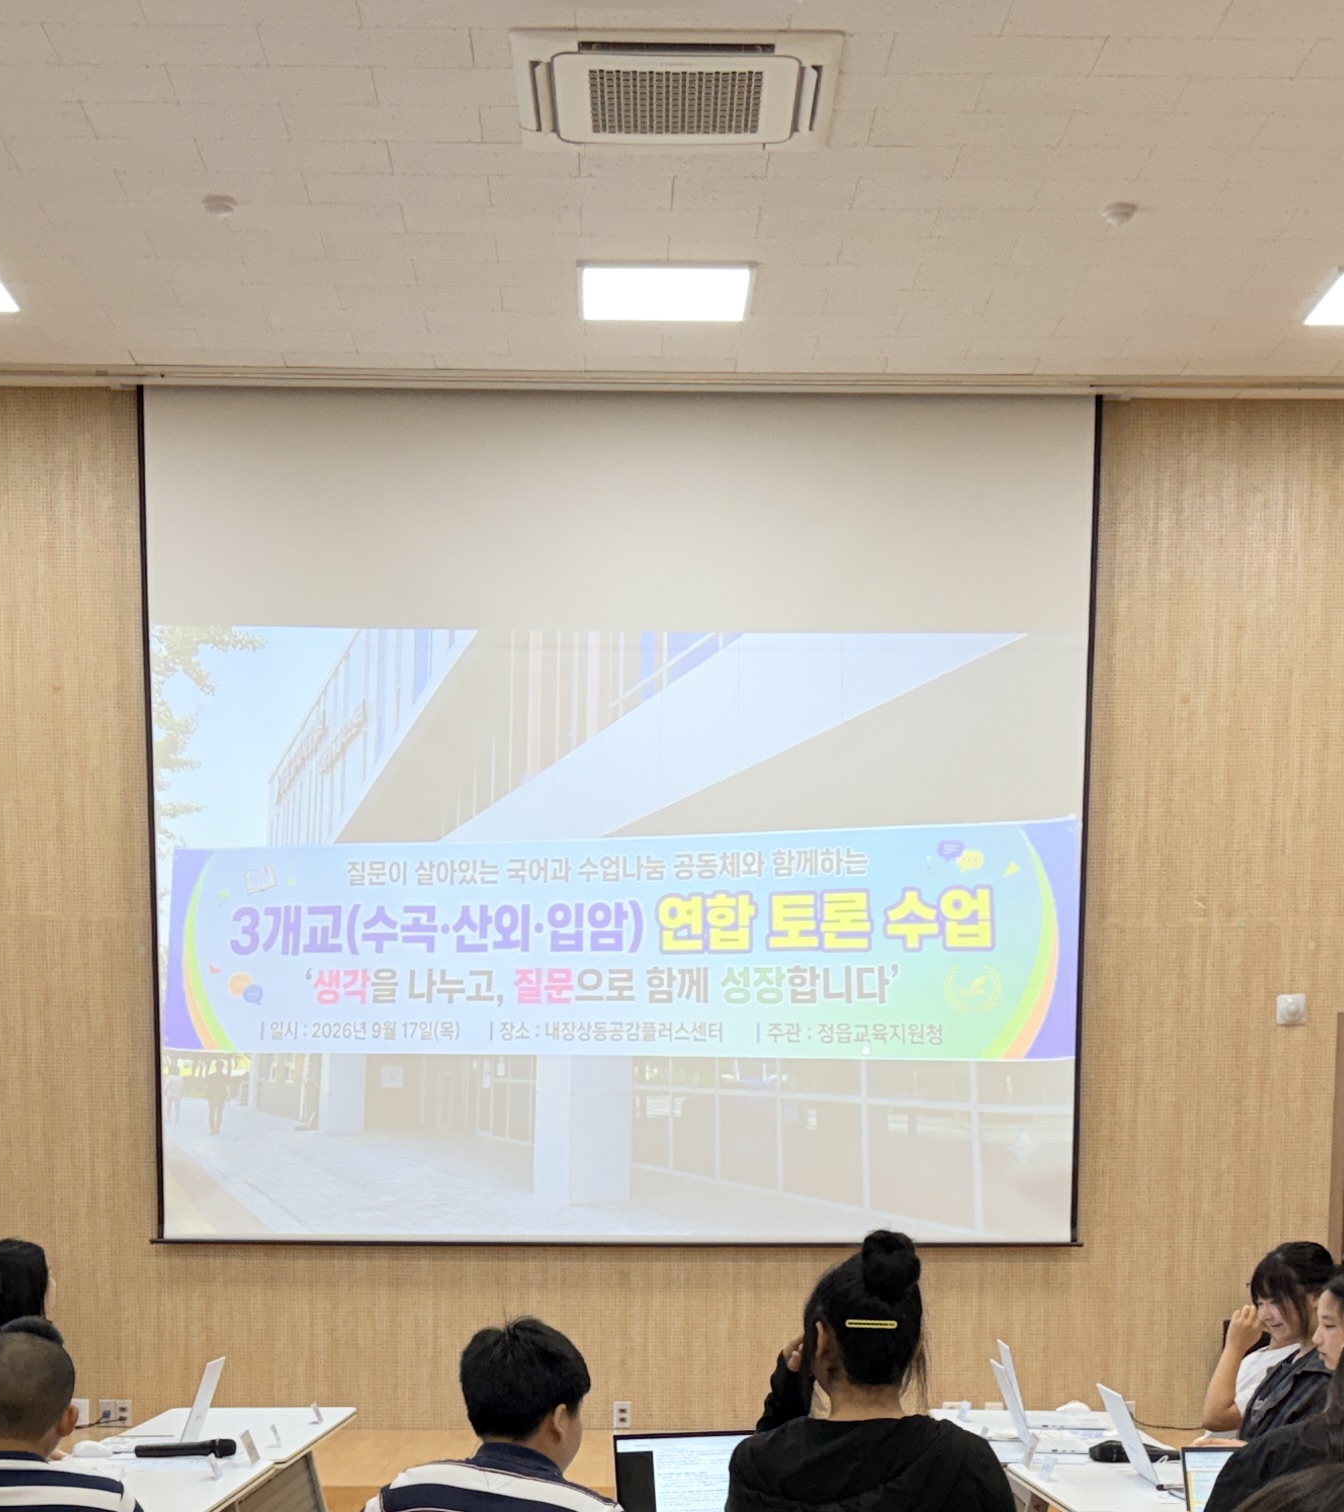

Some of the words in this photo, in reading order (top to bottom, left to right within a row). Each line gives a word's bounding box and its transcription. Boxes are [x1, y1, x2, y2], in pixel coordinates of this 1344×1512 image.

[346, 860, 408, 886] 질문이
[414, 859, 499, 885] 살아있는
[506, 857, 571, 884] 국어과
[577, 855, 666, 882] 수업나눔
[673, 851, 765, 880] 공동체와
[772, 848, 868, 877] 함께하는
[656, 890, 758, 953] 연합
[766, 888, 874, 952] 토론
[884, 885, 995, 951] 수업
[408, 968, 504, 1007] 나누고,
[513, 967, 635, 1005] 질문으로
[645, 966, 709, 1004] 함께
[270, 1021, 298, 1041] 일시
[311, 1021, 368, 1041] 2026년
[371, 1021, 397, 1041] 9월
[401, 1021, 460, 1042] 17일(목)
[499, 1021, 531, 1041] 장소
[545, 1021, 723, 1042] 내장상동공감플러스센터
[766, 1022, 801, 1043] 주관
[817, 1022, 943, 1045] 정읍교육지원청
